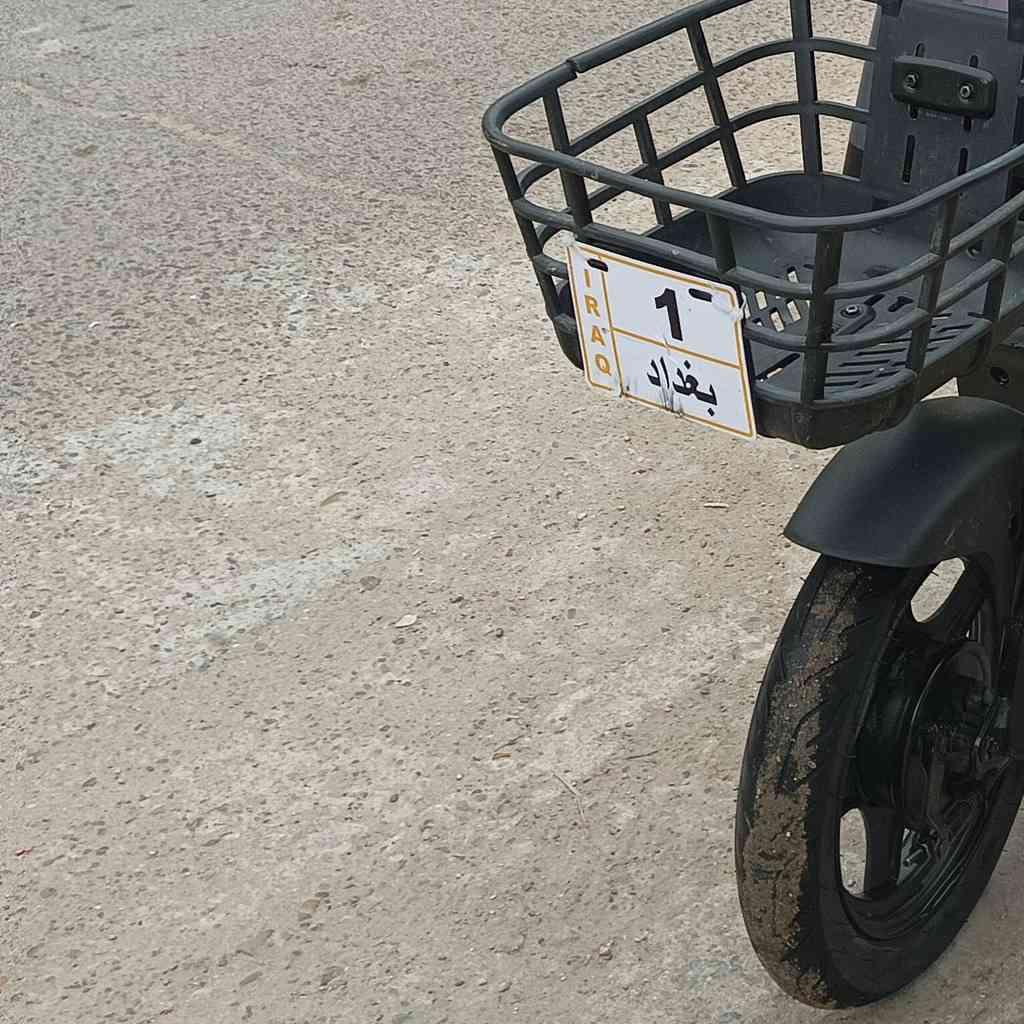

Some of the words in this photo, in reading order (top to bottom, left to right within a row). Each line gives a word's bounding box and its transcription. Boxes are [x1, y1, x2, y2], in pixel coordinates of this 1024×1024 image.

[584, 269, 611, 376] IRAQ
[655, 288, 683, 341] 1
[646, 356, 718, 417] بغداد
